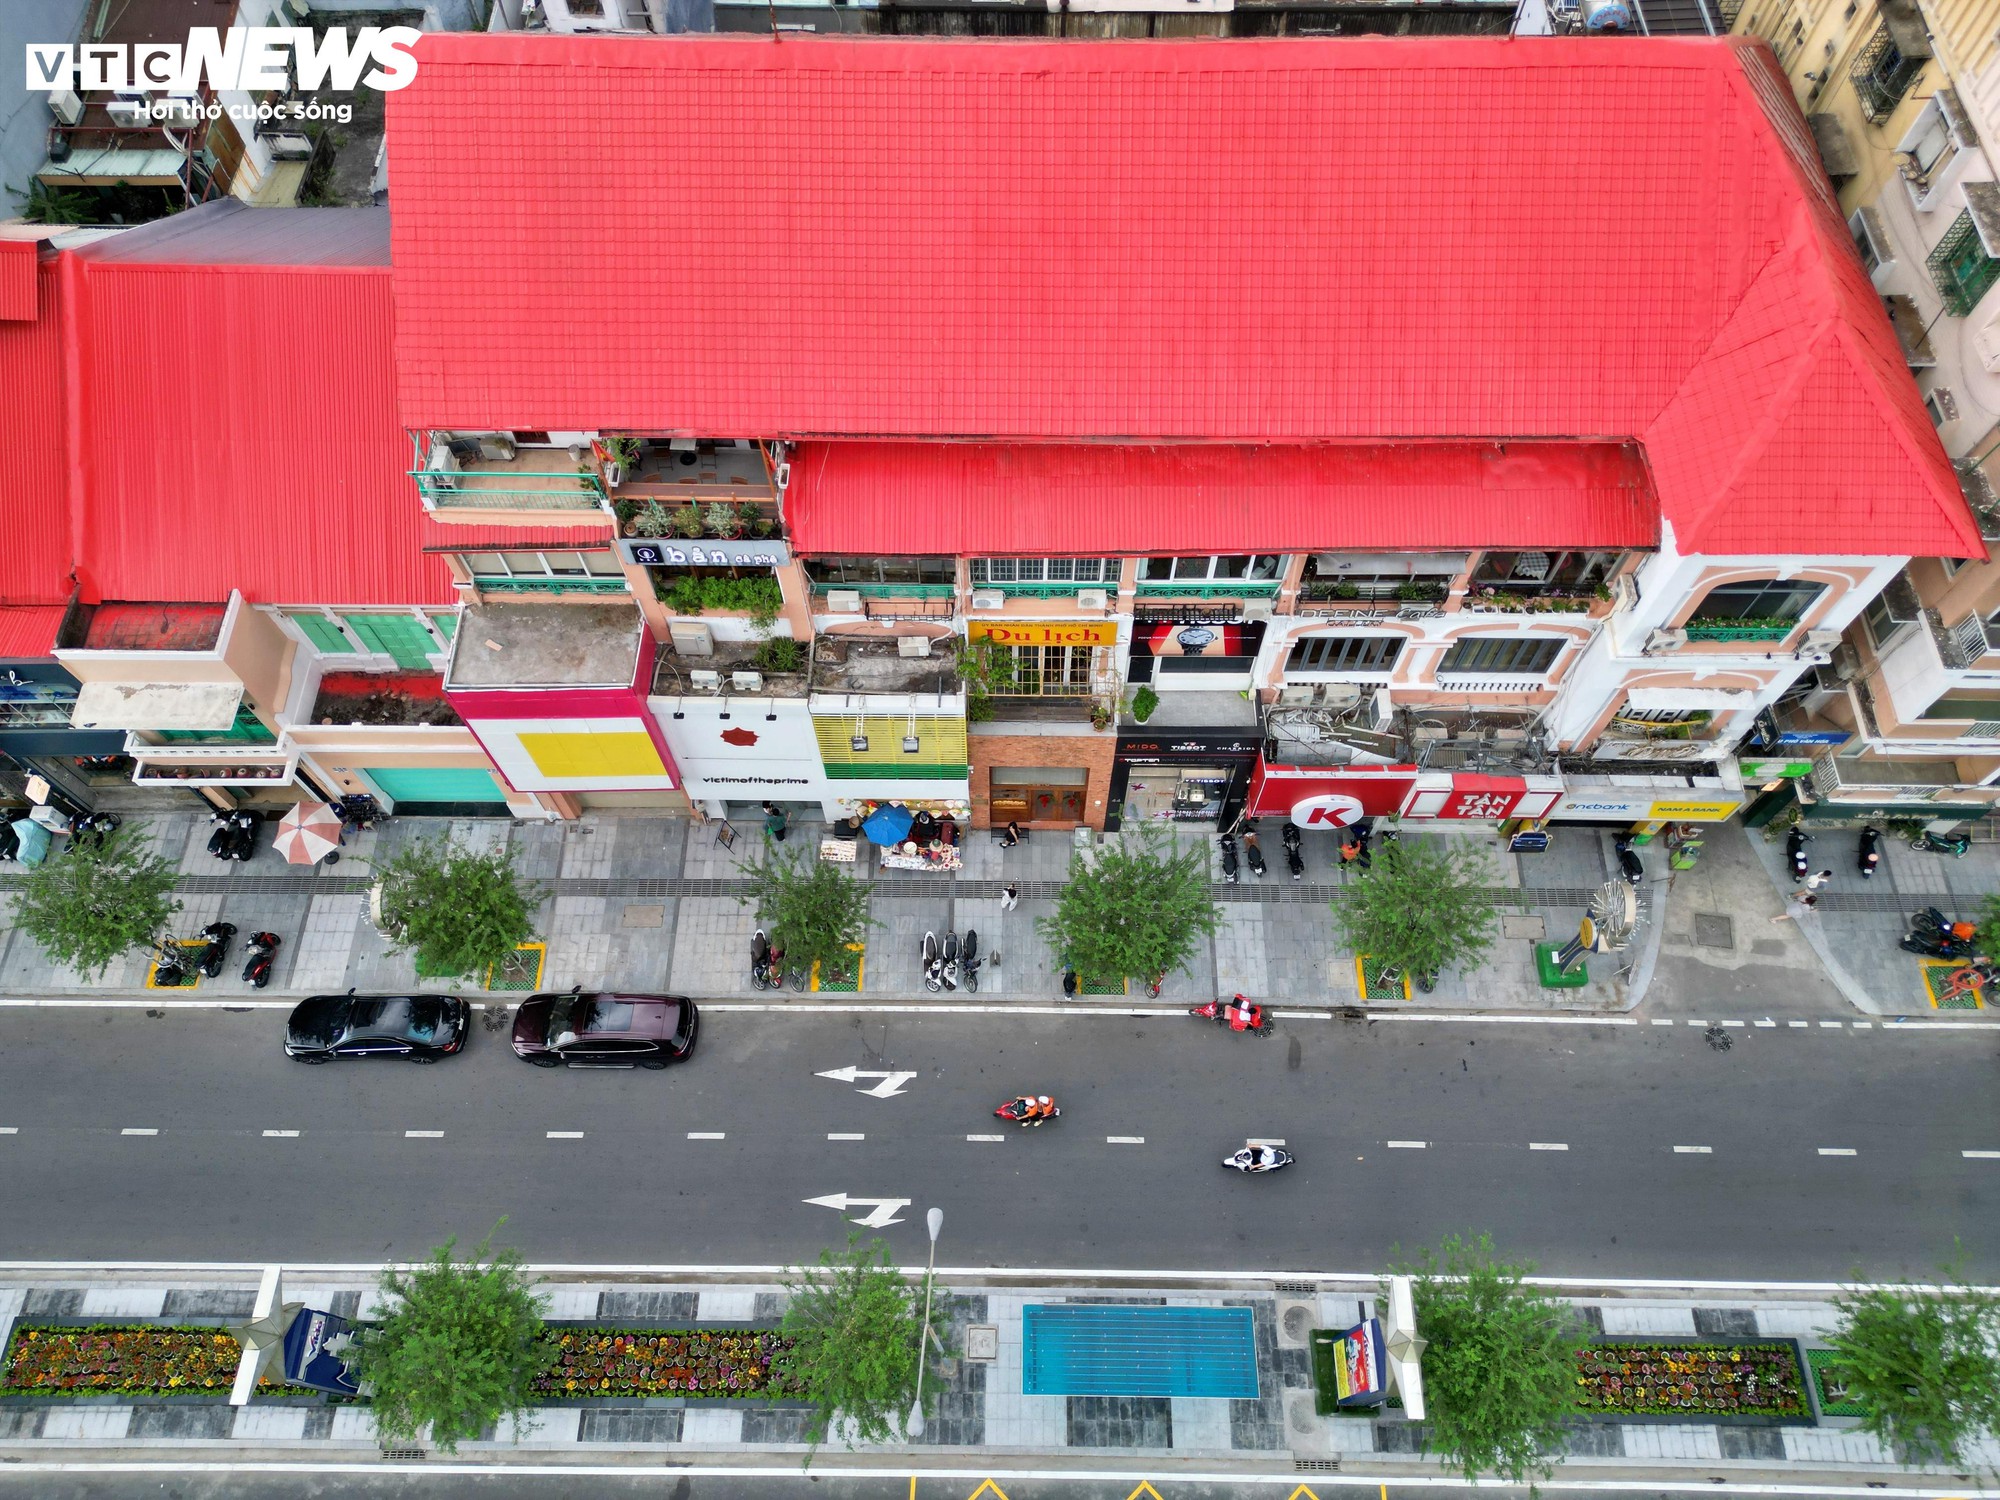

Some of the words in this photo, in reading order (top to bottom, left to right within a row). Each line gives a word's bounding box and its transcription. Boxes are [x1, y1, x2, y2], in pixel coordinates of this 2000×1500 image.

[666, 546, 728, 563] bản
[985, 629, 1030, 641] Du
[1043, 629, 1101, 643] lịch
[703, 777, 809, 785] victimoftheprime
[1463, 793, 1512, 805] TÂN
[1457, 805, 1504, 815] TÂN
[1307, 808, 1353, 828] K
